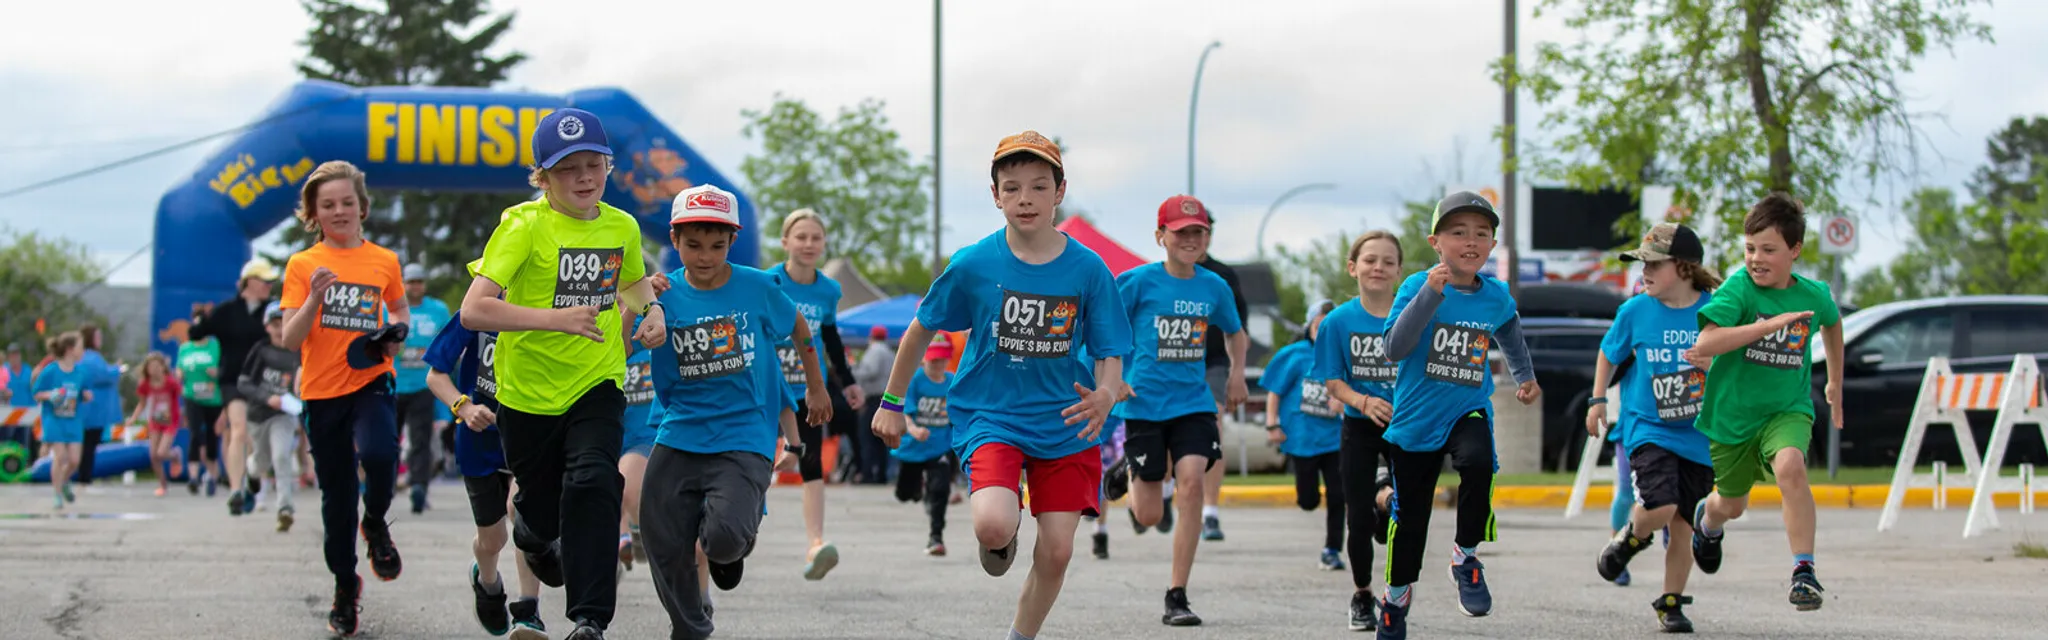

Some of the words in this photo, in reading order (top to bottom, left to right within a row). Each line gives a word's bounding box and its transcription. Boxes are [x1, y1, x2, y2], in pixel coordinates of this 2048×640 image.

[559, 253, 600, 281] 039
[324, 285, 360, 307] 048
[568, 283, 574, 291] 3
[575, 282, 590, 291] KM
[554, 294, 589, 307] EDDIE'S
[1004, 296, 1046, 327] 051
[1020, 327, 1035, 336] KM
[1158, 319, 1192, 339] 029
[672, 327, 710, 354] 049
[998, 336, 1035, 352] EDDIE'S
[1036, 340, 1051, 352] BIG
[1052, 340, 1071, 352] RUN
[1350, 335, 1384, 357] 028
[1433, 328, 1470, 356] 041
[680, 363, 708, 376] EDDIE'S
[708, 361, 722, 373] BIG
[723, 355, 743, 370] RUN
[1646, 348, 1673, 363] BIG
[1745, 348, 1776, 364] EDDIE'S
[1776, 354, 1788, 365] BIG
[1427, 362, 1458, 378] EDDIE'S
[1459, 367, 1472, 380] BIG
[1653, 375, 1685, 400] 073
